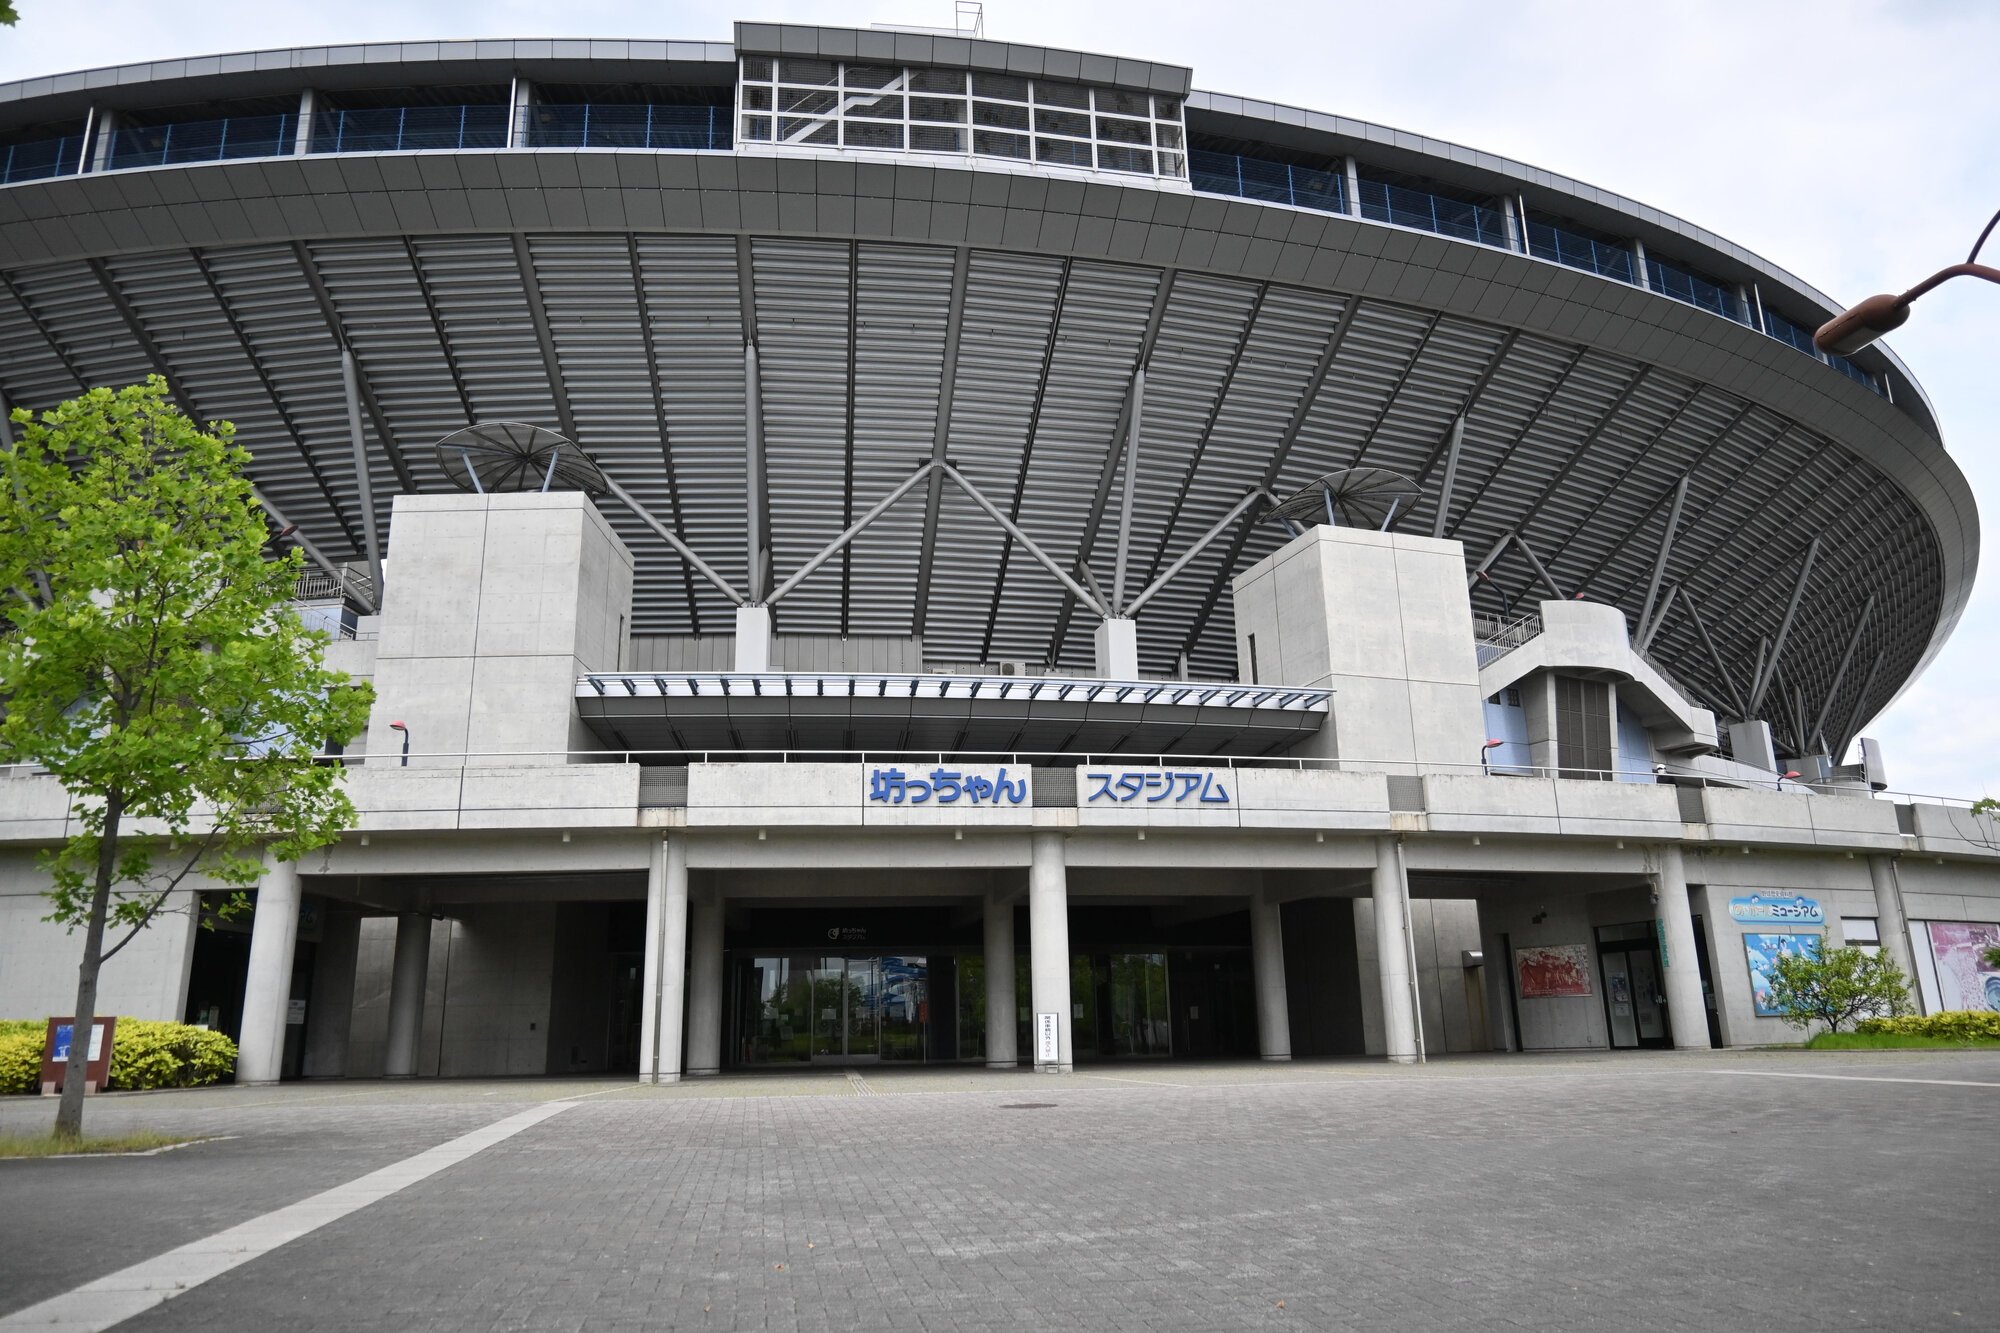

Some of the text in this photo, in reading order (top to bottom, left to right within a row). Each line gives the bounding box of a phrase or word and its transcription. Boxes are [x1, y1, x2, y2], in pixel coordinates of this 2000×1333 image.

[869, 767, 1231, 804] 坊っちゃん スタジアム
